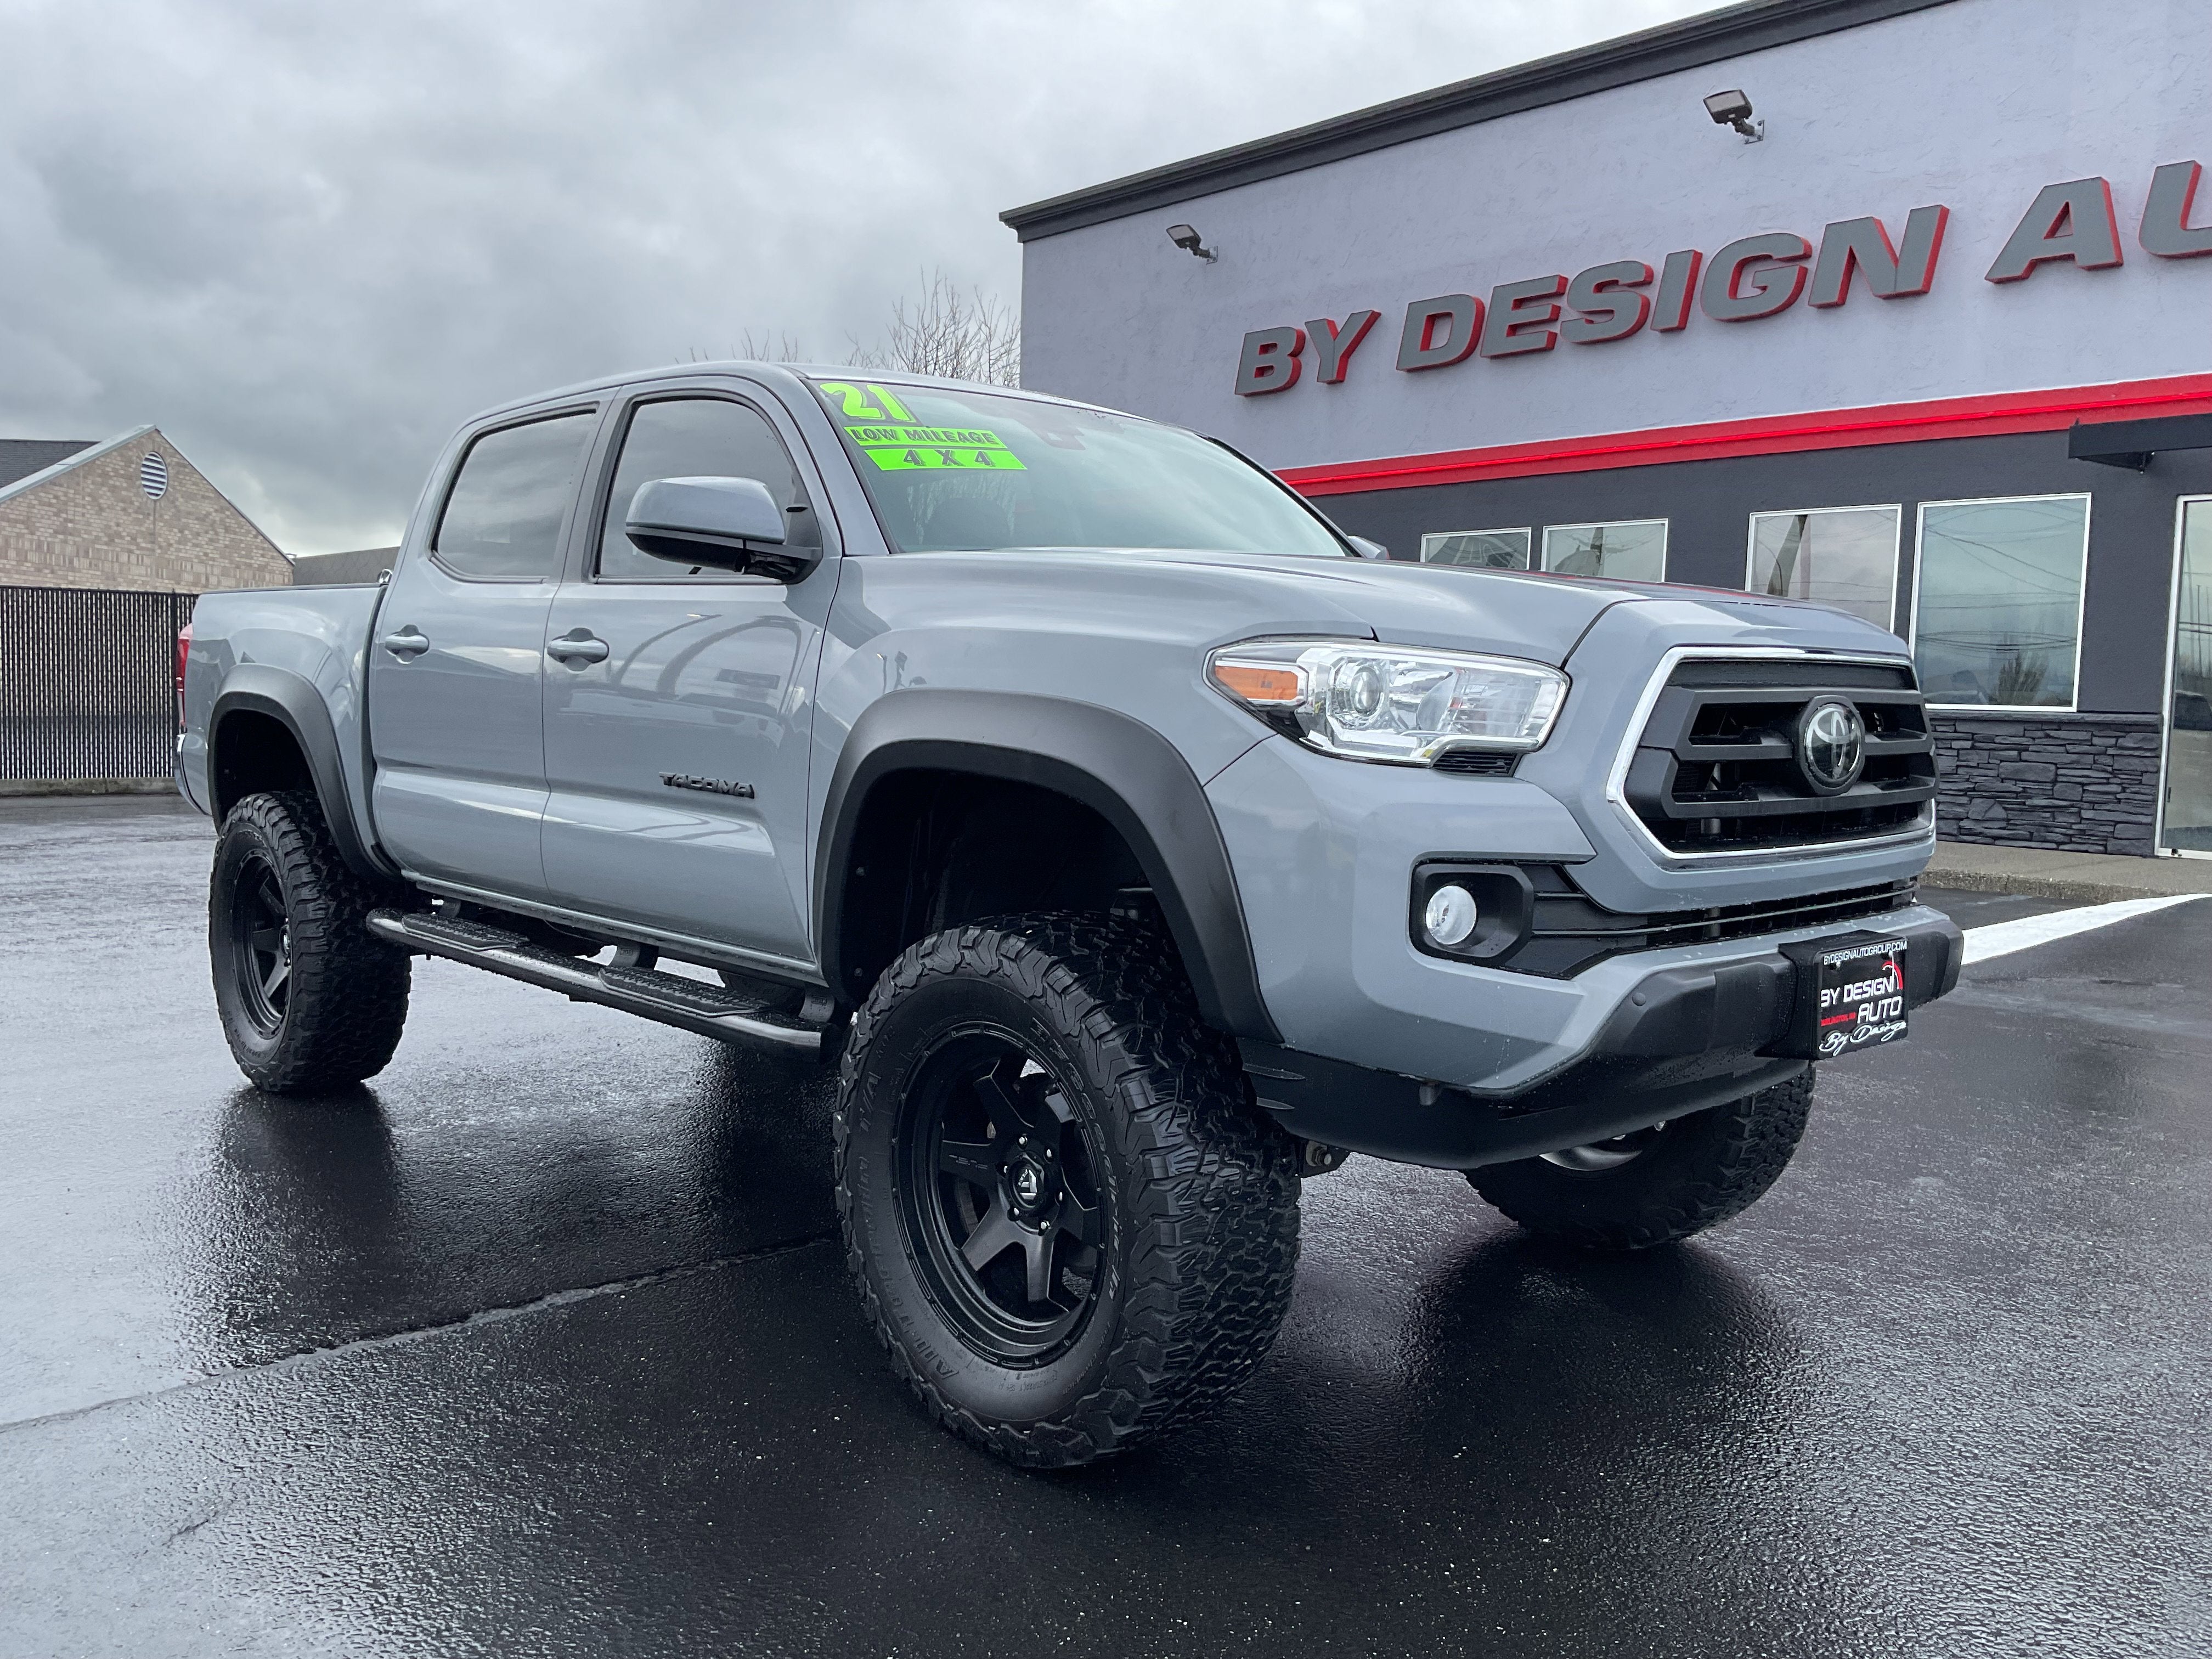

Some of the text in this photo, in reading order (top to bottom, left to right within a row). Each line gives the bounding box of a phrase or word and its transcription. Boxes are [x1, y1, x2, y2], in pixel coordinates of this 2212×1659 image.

[1234, 309, 1381, 397] BY
[1396, 204, 1950, 372] DESIGN
[820, 382, 916, 422] 21
[850, 428, 1000, 445] LOW MILEAGE
[903, 449, 926, 466] 4
[973, 450, 995, 466] 4
[659, 771, 754, 799] TACOMA
[1843, 975, 1893, 1002] DESIGN
[1857, 995, 1902, 1024] AUTO
[1819, 1021, 1907, 1056] By Design
